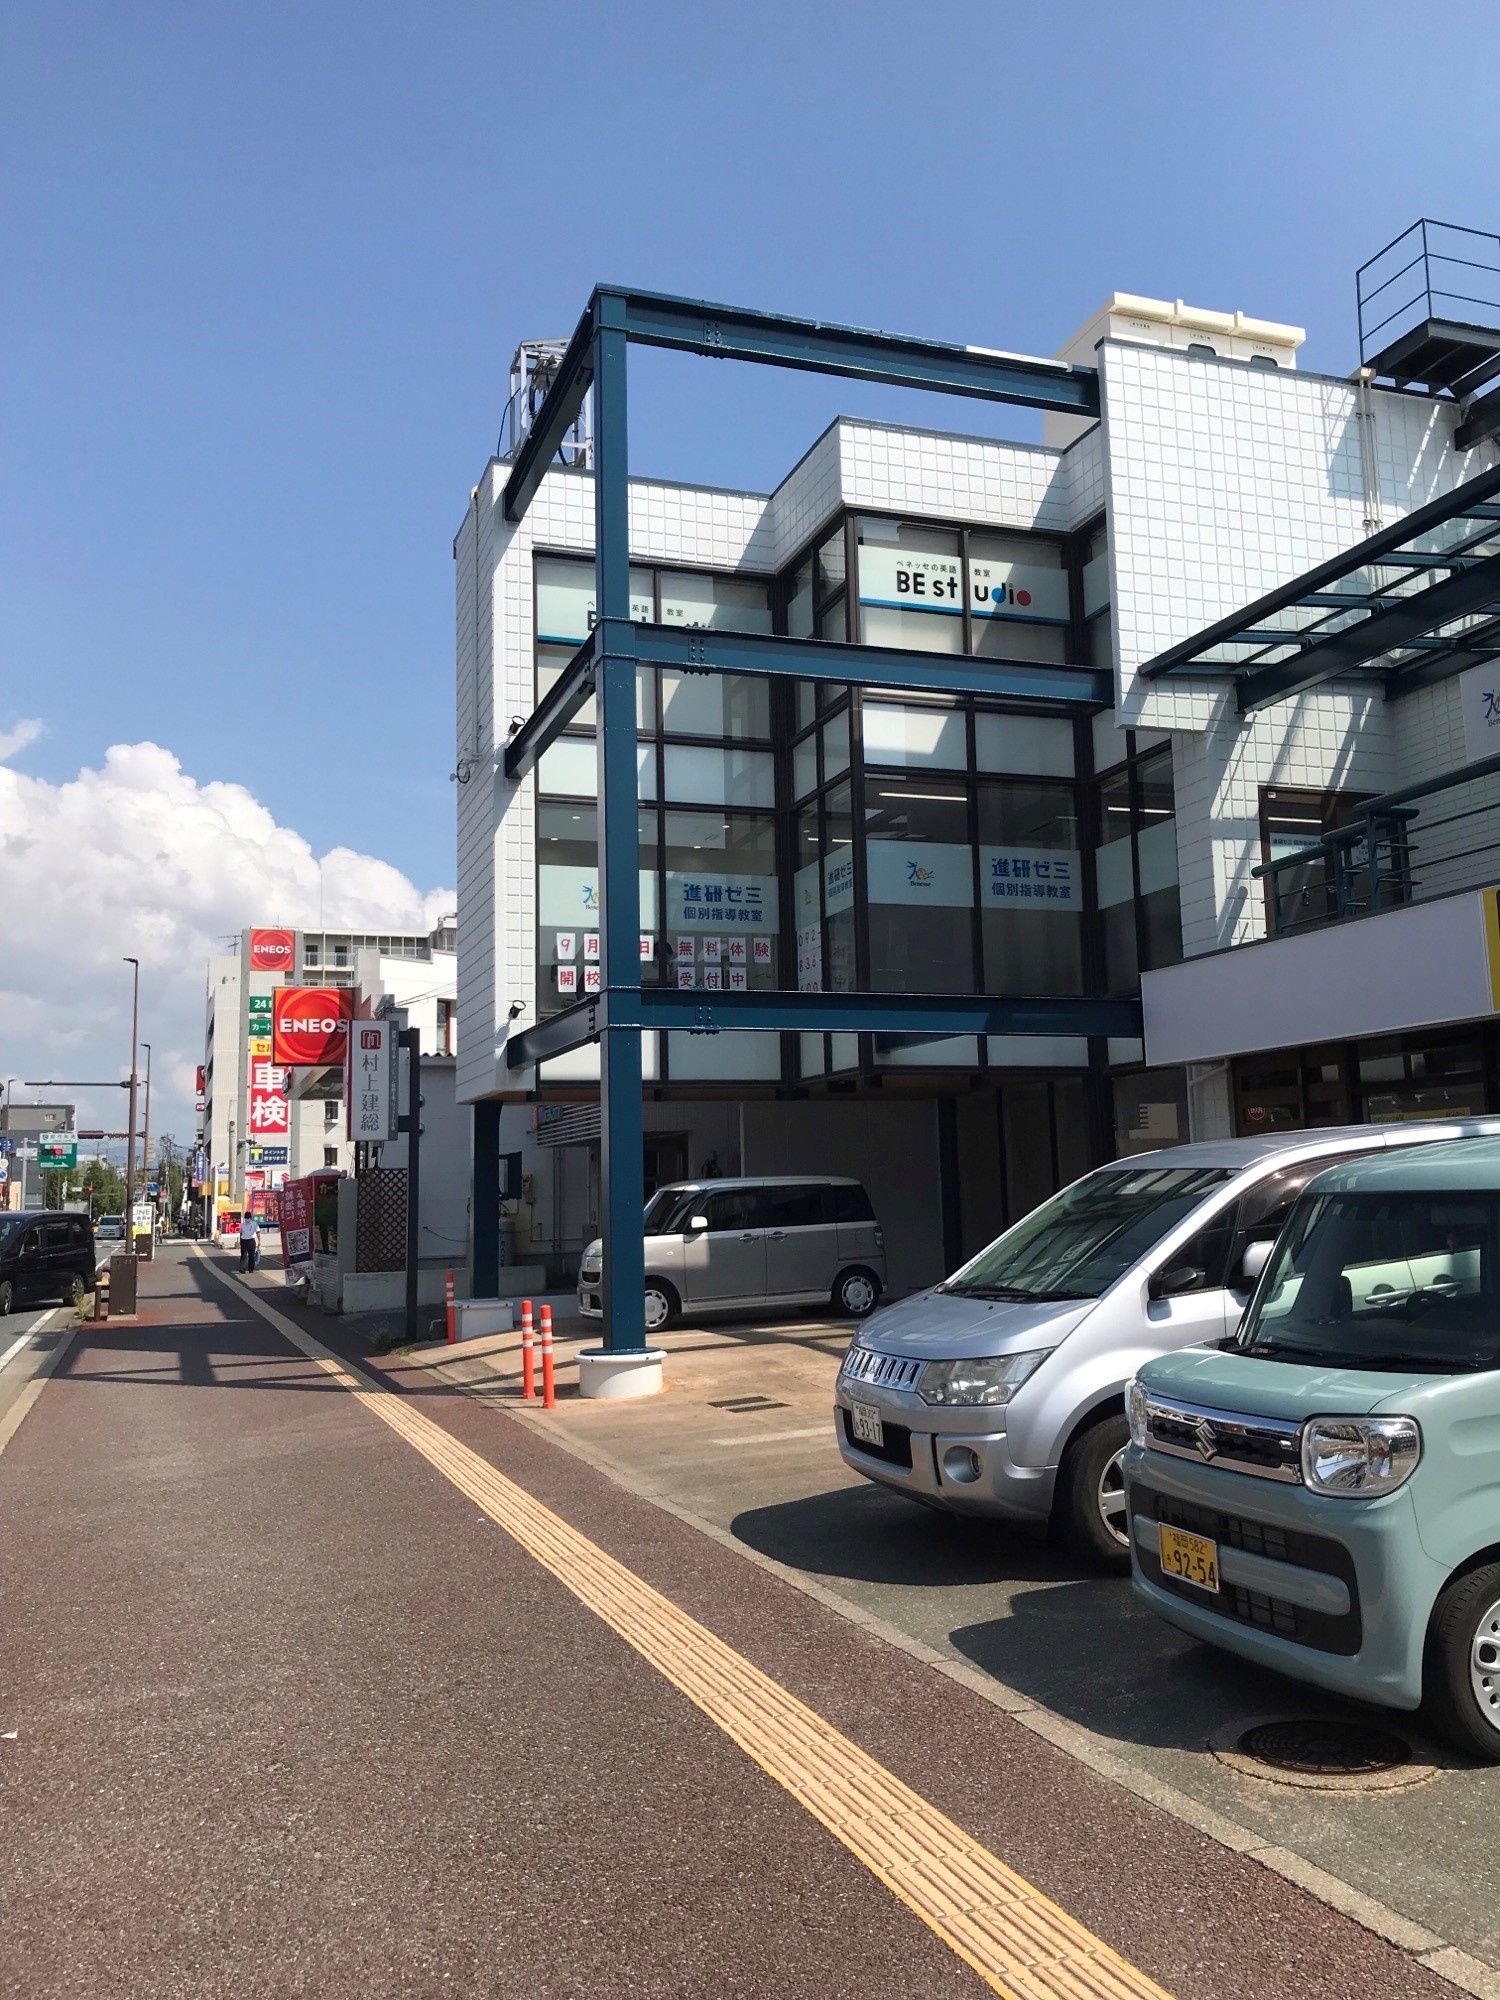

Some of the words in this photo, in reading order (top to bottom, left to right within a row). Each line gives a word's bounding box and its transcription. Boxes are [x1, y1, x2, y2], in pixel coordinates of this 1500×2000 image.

[991, 857, 1071, 880] 進研ゼミ
[683, 882, 764, 904] 進研ゼミ
[991, 881, 1072, 899] 個別指導教室
[683, 905, 763, 923] 個別指導教室
[253, 945, 291, 954] ENEOS
[678, 940, 769, 957] 無料体験
[679, 971, 745, 988] 受付中
[279, 1018, 348, 1034] ENEOS
[251, 1063, 288, 1128] 車検
[360, 1053, 380, 1132] 村上建総
[225, 1222, 241, 1233] 162
[859, 1418, 881, 1442] 93-17
[1188, 1537, 1204, 1555] 582
[1173, 1549, 1217, 1590] 92-54
